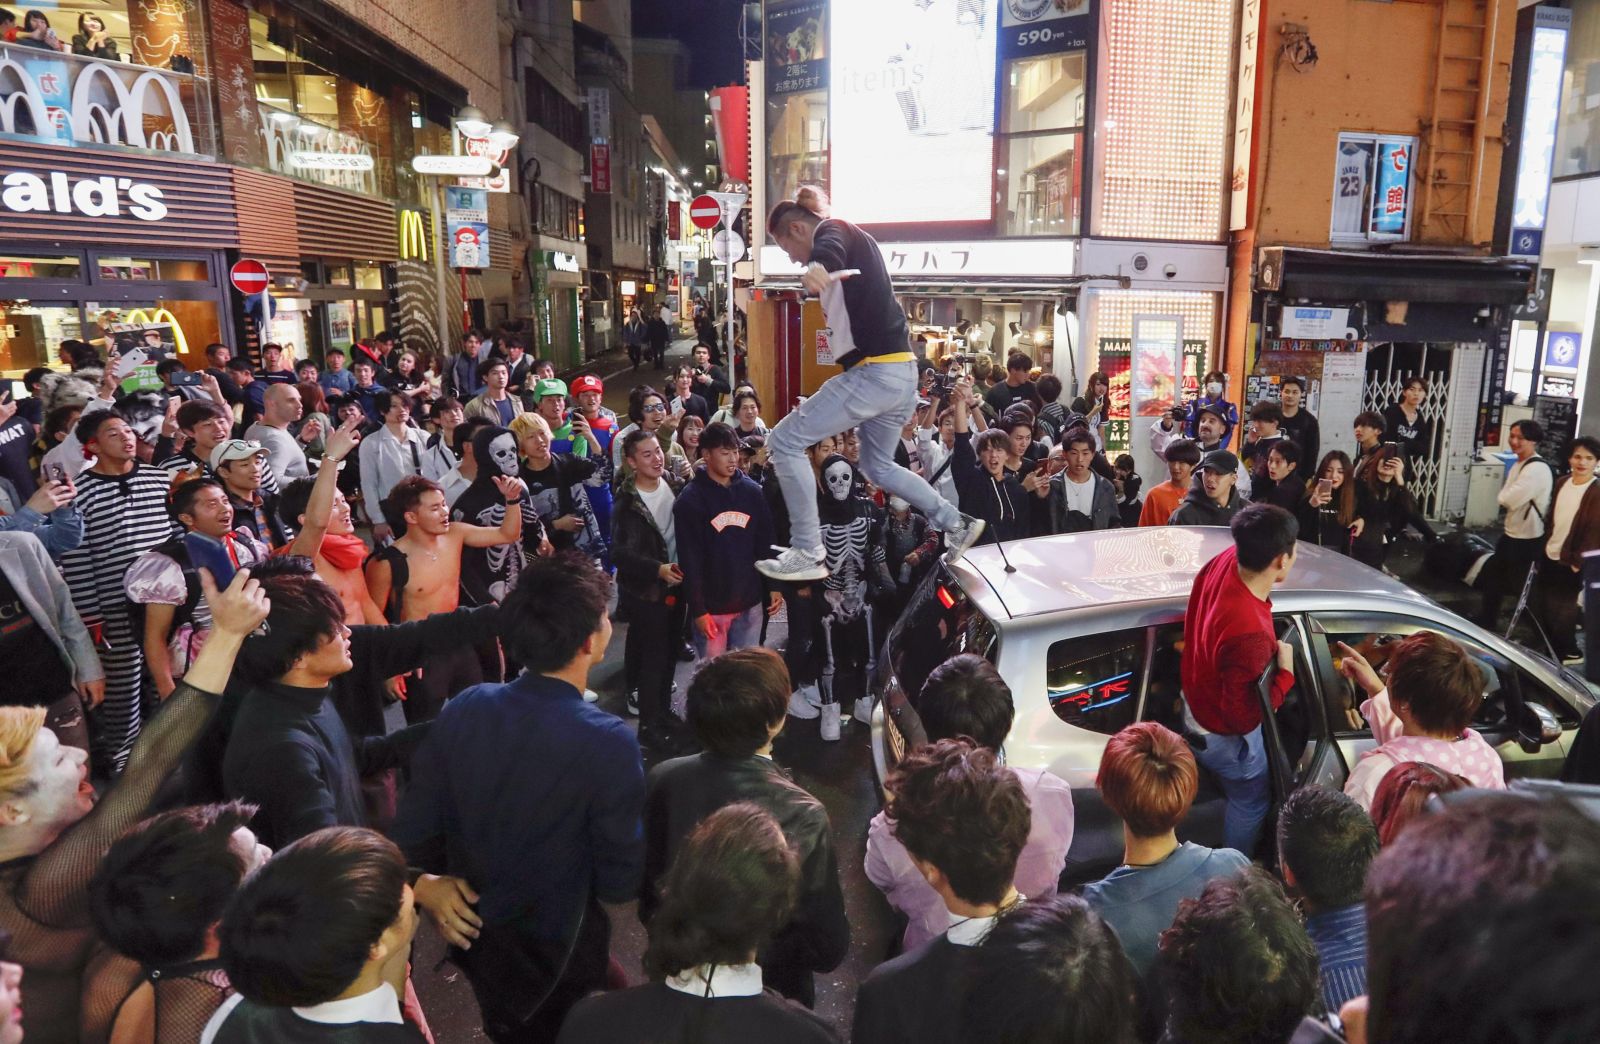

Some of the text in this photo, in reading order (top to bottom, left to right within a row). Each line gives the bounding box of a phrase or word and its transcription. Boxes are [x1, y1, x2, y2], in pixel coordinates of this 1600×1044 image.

[1017, 28, 1065, 46] 590 yen
[1073, 39, 1086, 47] tax
[786, 64, 808, 77] 2階に
[775, 73, 820, 92] お席あります
[1342, 165, 1360, 175] JAMES
[1340, 176, 1360, 198] 23
[2, 171, 168, 221] ald's
[1104, 342, 1202, 353] MAM AFE
[1111, 422, 1130, 431] S 3
[1110, 431, 1129, 441] M 4
